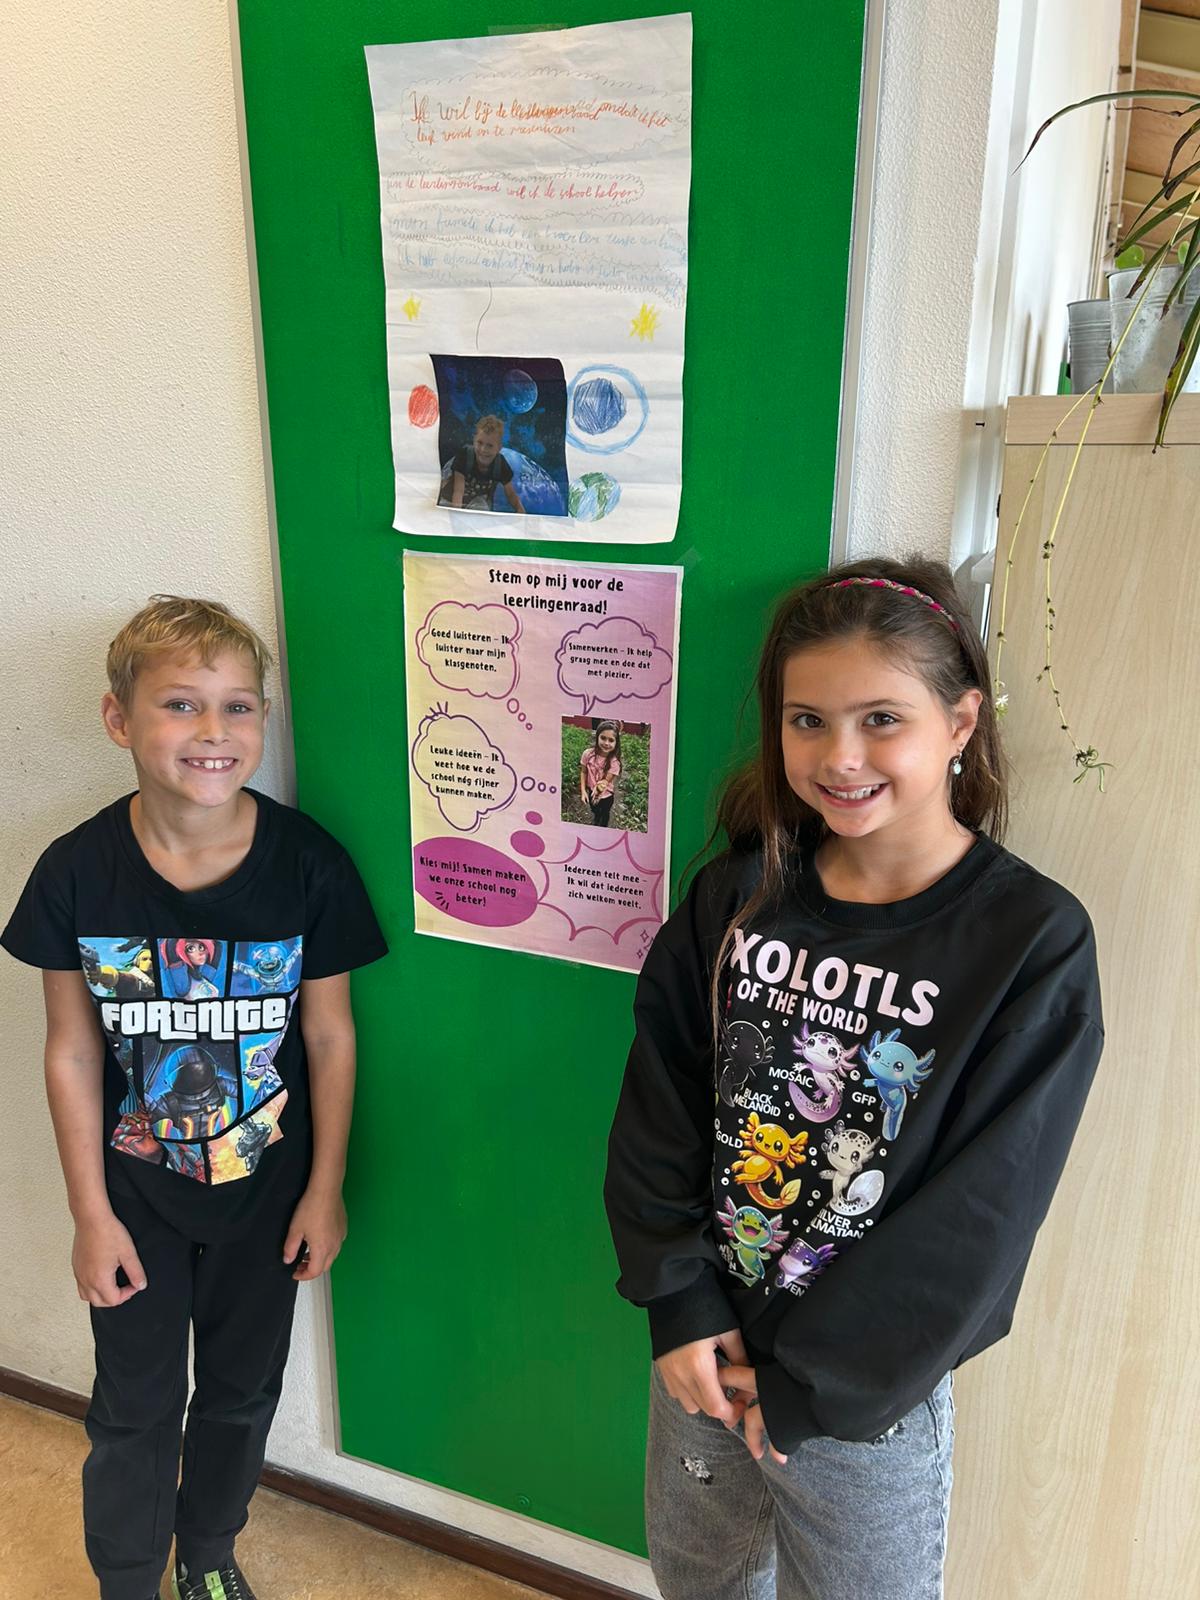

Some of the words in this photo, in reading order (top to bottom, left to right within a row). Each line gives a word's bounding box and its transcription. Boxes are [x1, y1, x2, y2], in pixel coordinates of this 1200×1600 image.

[488, 569, 521, 584] Stem
[526, 574, 540, 589] op
[545, 574, 567, 590] mij
[572, 578, 603, 590] voor
[607, 577, 624, 592] de
[503, 593, 607, 615] leerlingenraad!
[431, 627, 451, 639] Goed
[453, 630, 492, 642] luisteren
[501, 635, 510, 645] Ik
[435, 643, 463, 653] luister
[466, 647, 484, 656] naar
[487, 648, 506, 659] mijn
[568, 642, 618, 654] Samenwerken
[627, 647, 634, 656] Ik
[637, 648, 653, 658] help
[445, 658, 497, 672] klasgenoten.
[570, 656, 591, 665] graag
[622, 659, 635, 668] doe
[638, 661, 650, 669] dat
[587, 669, 602, 677] met
[604, 670, 632, 680] plezier.
[430, 745, 454, 756] Leuke
[491, 753, 499, 762] Ik
[434, 760, 453, 769] weet
[456, 762, 470, 771] hoe
[485, 766, 496, 775] de
[431, 773, 455, 782] school
[457, 775, 472, 786] nóg
[474, 777, 499, 788] fijner
[435, 785, 464, 796] kunnen
[467, 790, 495, 801] maken.
[419, 856, 438, 868] Kies
[440, 861, 460, 873] mij!
[462, 863, 492, 877] Samen
[495, 869, 526, 882] maken
[564, 864, 602, 877] Iedereen
[604, 871, 620, 880] telt
[622, 875, 640, 883] mee
[429, 874, 441, 883] we
[444, 877, 465, 887] onze
[468, 881, 497, 892] school
[499, 886, 517, 898] nog
[567, 876, 575, 885] Ik
[578, 879, 588, 887] wil
[590, 881, 604, 889] dat
[607, 883, 644, 896] iedereen
[455, 892, 487, 907] beter!
[568, 890, 584, 899] zich
[586, 893, 615, 904] welkom
[618, 900, 642, 910] voelt.
[737, 978, 763, 1003] OF
[766, 986, 799, 1015] THE
[802, 997, 869, 1035] WORLD
[768, 1066, 815, 1088] MOSAIC
[733, 1092, 781, 1117] MELANOID
[743, 1087, 773, 1105] BLACK
[851, 1091, 877, 1107] GFP
[715, 1130, 744, 1149] GOLD
[810, 1216, 864, 1240] LMATIAN
